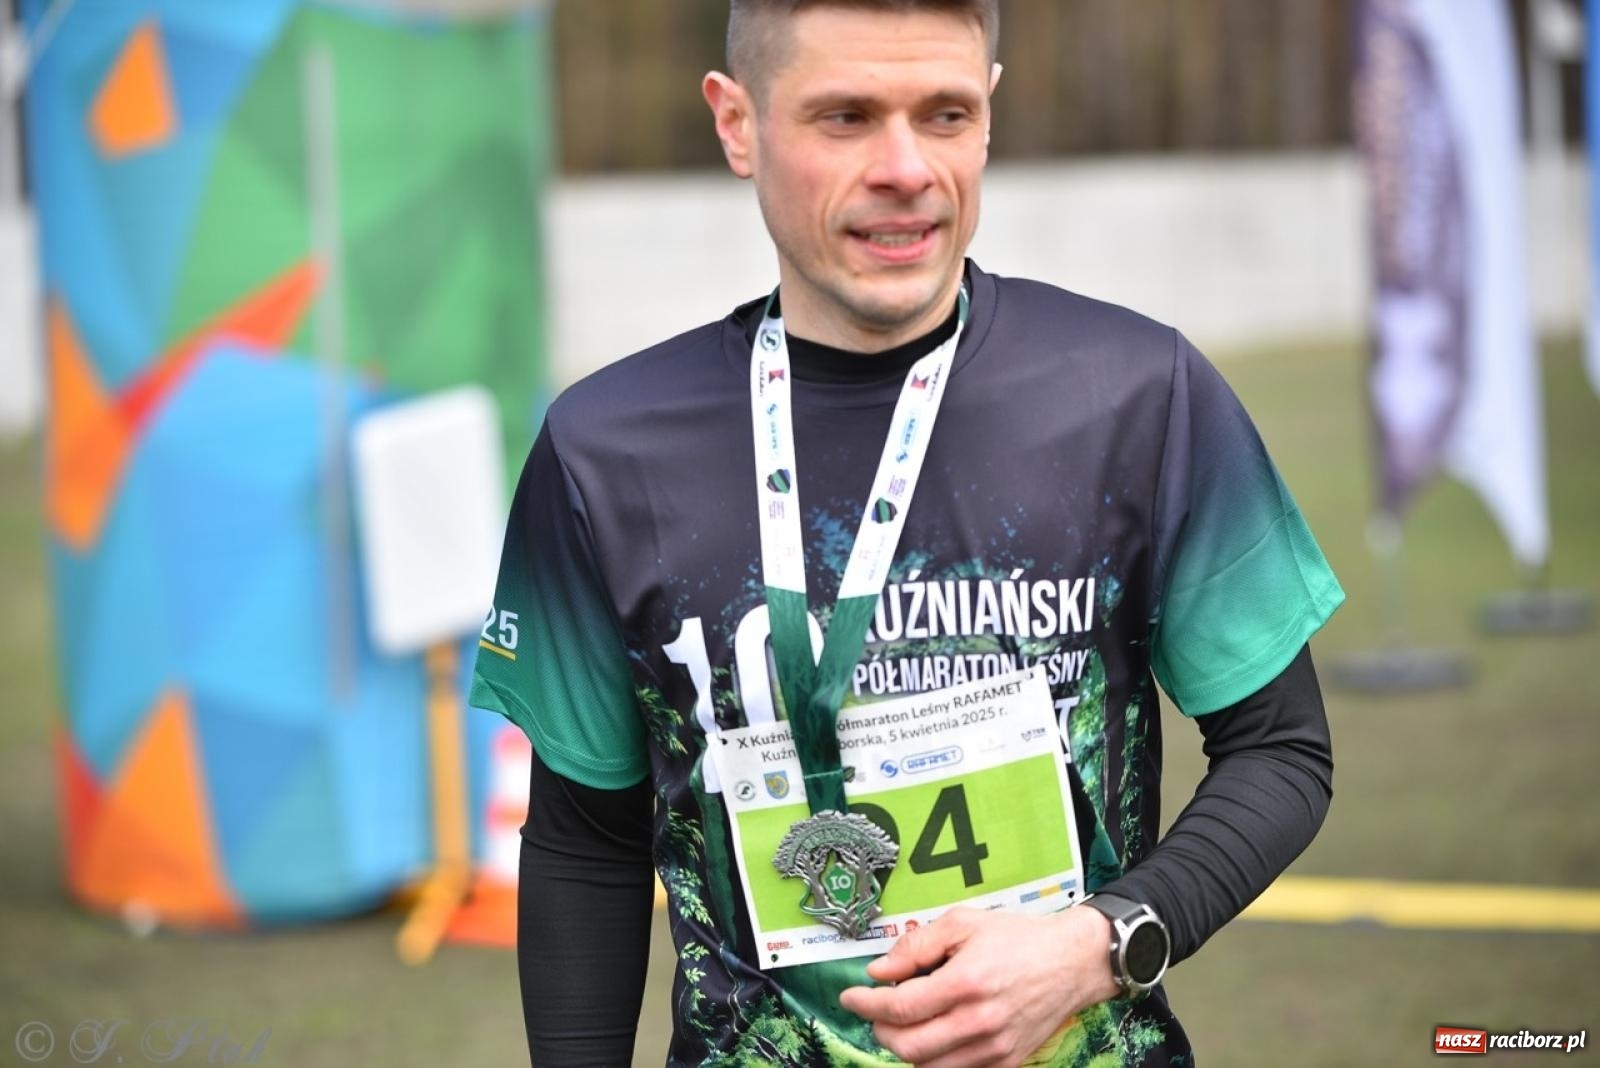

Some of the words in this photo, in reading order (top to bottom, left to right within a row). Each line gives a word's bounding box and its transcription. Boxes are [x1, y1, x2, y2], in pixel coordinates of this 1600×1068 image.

[865, 568, 1095, 643] UŹNIAŃSKI
[737, 737, 749, 750] X
[837, 710, 909, 731] ółmaraton
[911, 701, 951, 720] Leśny
[954, 681, 1022, 709] RAFAMET
[762, 748, 796, 762] Kuźn
[839, 733, 887, 750] borska,
[889, 731, 898, 743] 5
[900, 716, 960, 740] kwietnia
[962, 707, 997, 726] 2025
[998, 705, 1009, 717] r.
